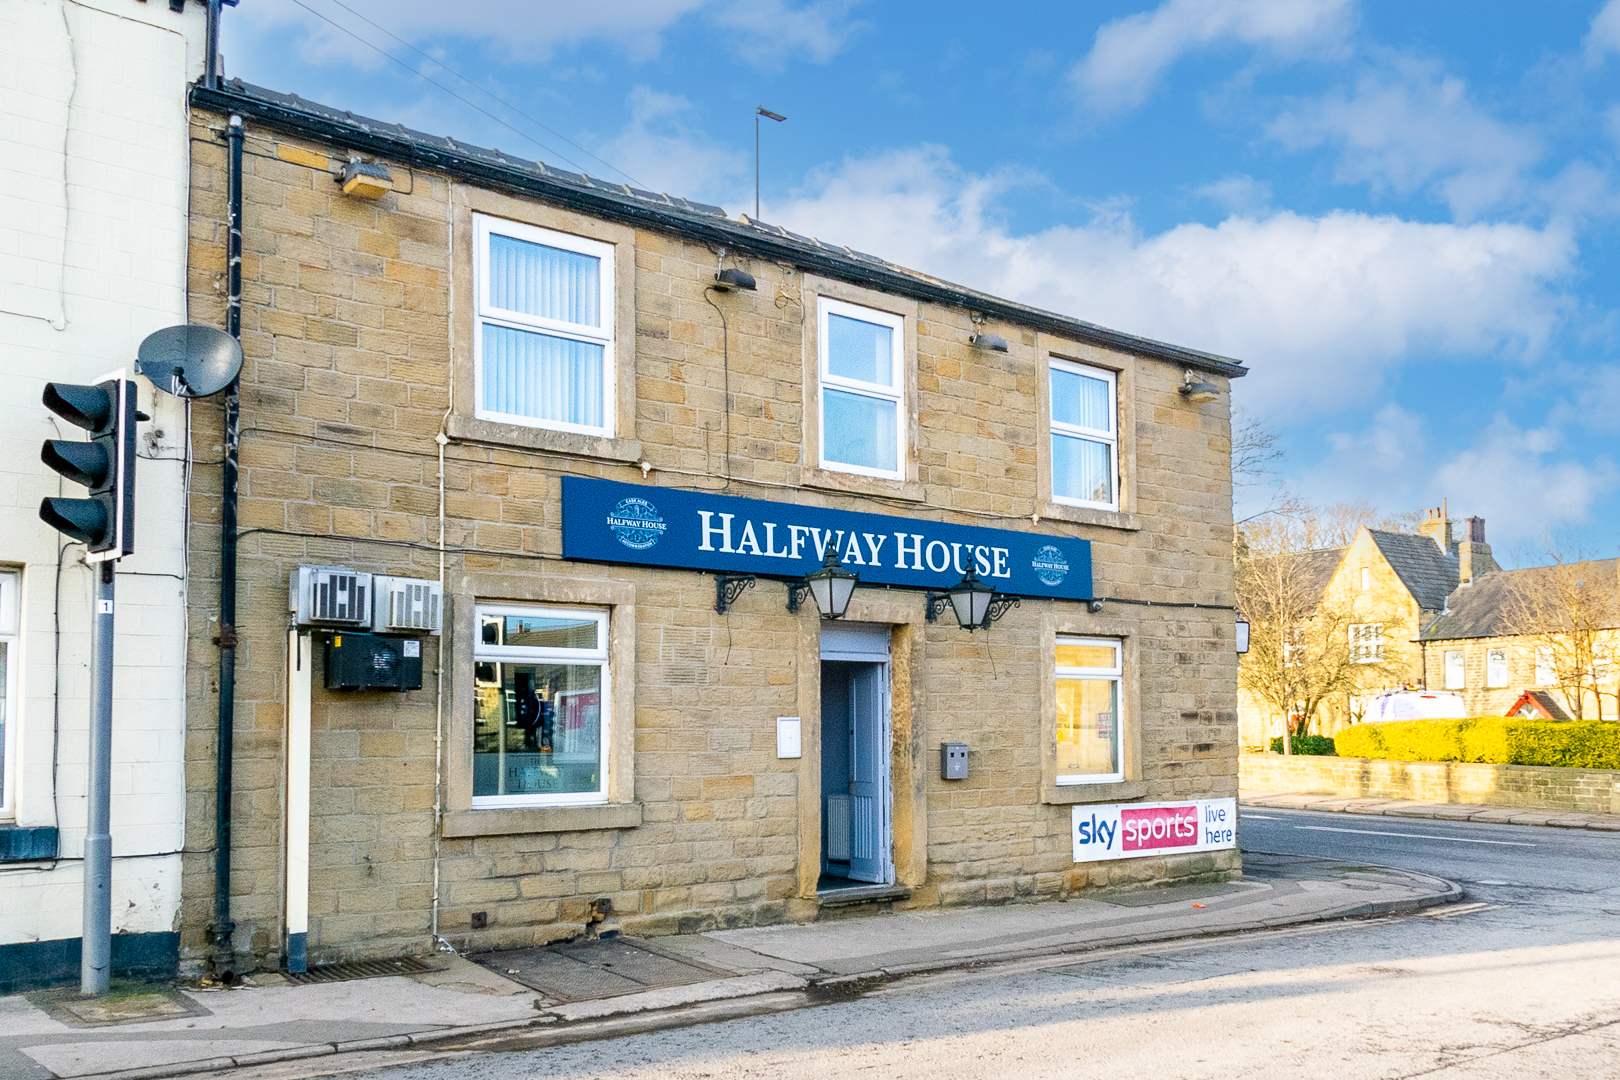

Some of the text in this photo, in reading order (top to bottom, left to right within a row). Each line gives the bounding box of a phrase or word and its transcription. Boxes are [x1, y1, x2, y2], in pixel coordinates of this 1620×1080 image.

[607, 516, 667, 530] HALFWAY HOUSE
[697, 510, 1011, 578] HALFWAY HOUSE
[103, 601, 108, 611] 1
[1205, 805, 1226, 823] live
[1078, 813, 1195, 850] sky sports
[1205, 827, 1232, 844] here
